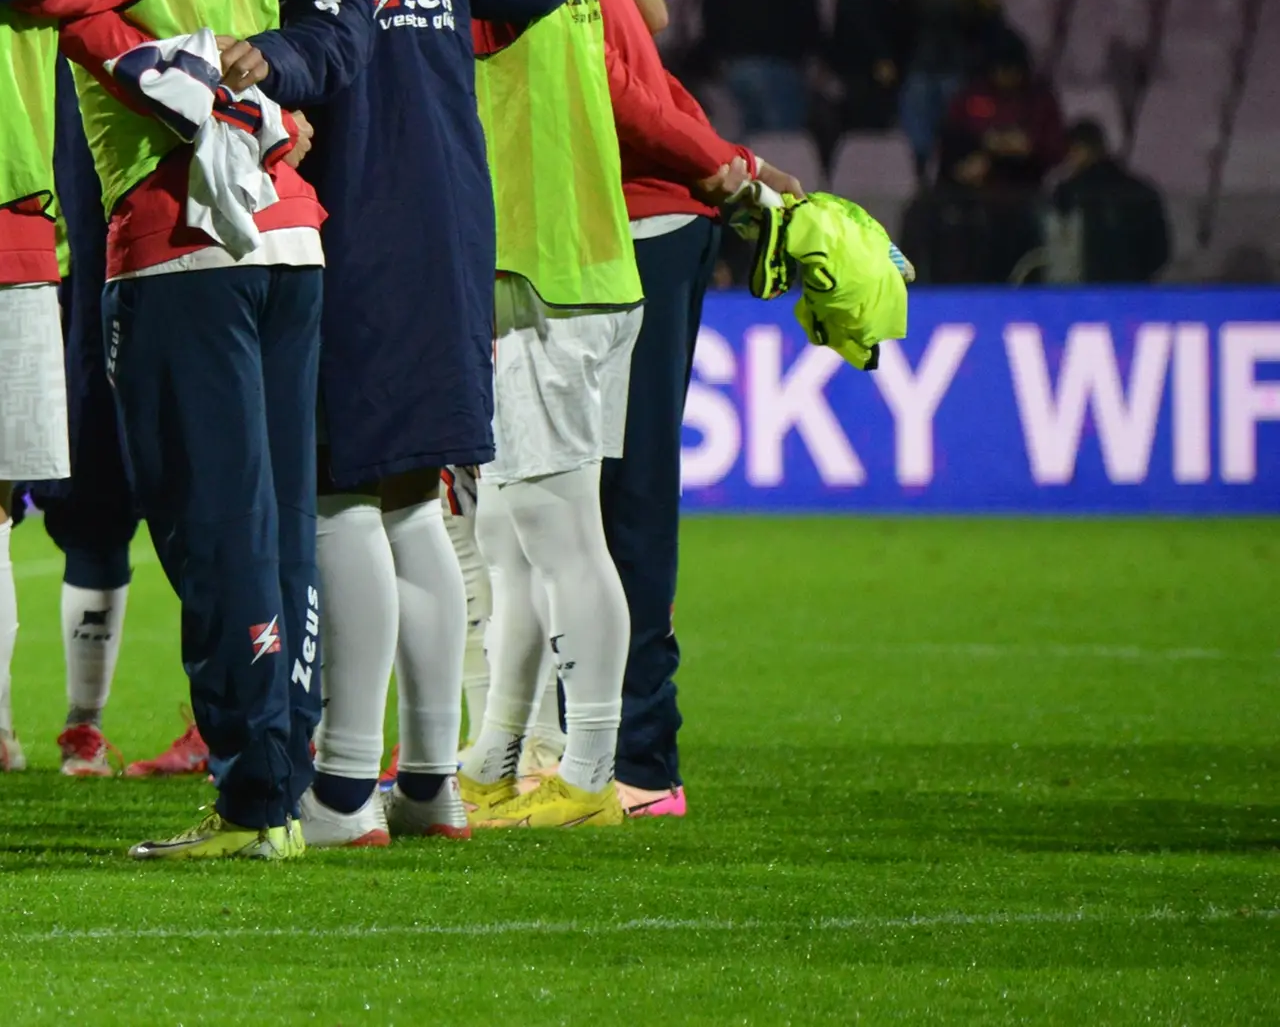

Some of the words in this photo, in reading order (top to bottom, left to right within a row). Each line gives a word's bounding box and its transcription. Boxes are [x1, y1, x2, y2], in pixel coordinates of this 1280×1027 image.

[379, 13, 428, 30] veste
[683, 324, 975, 489] SKY
[1003, 322, 1280, 486] WIF
[291, 584, 319, 694] Zeus
